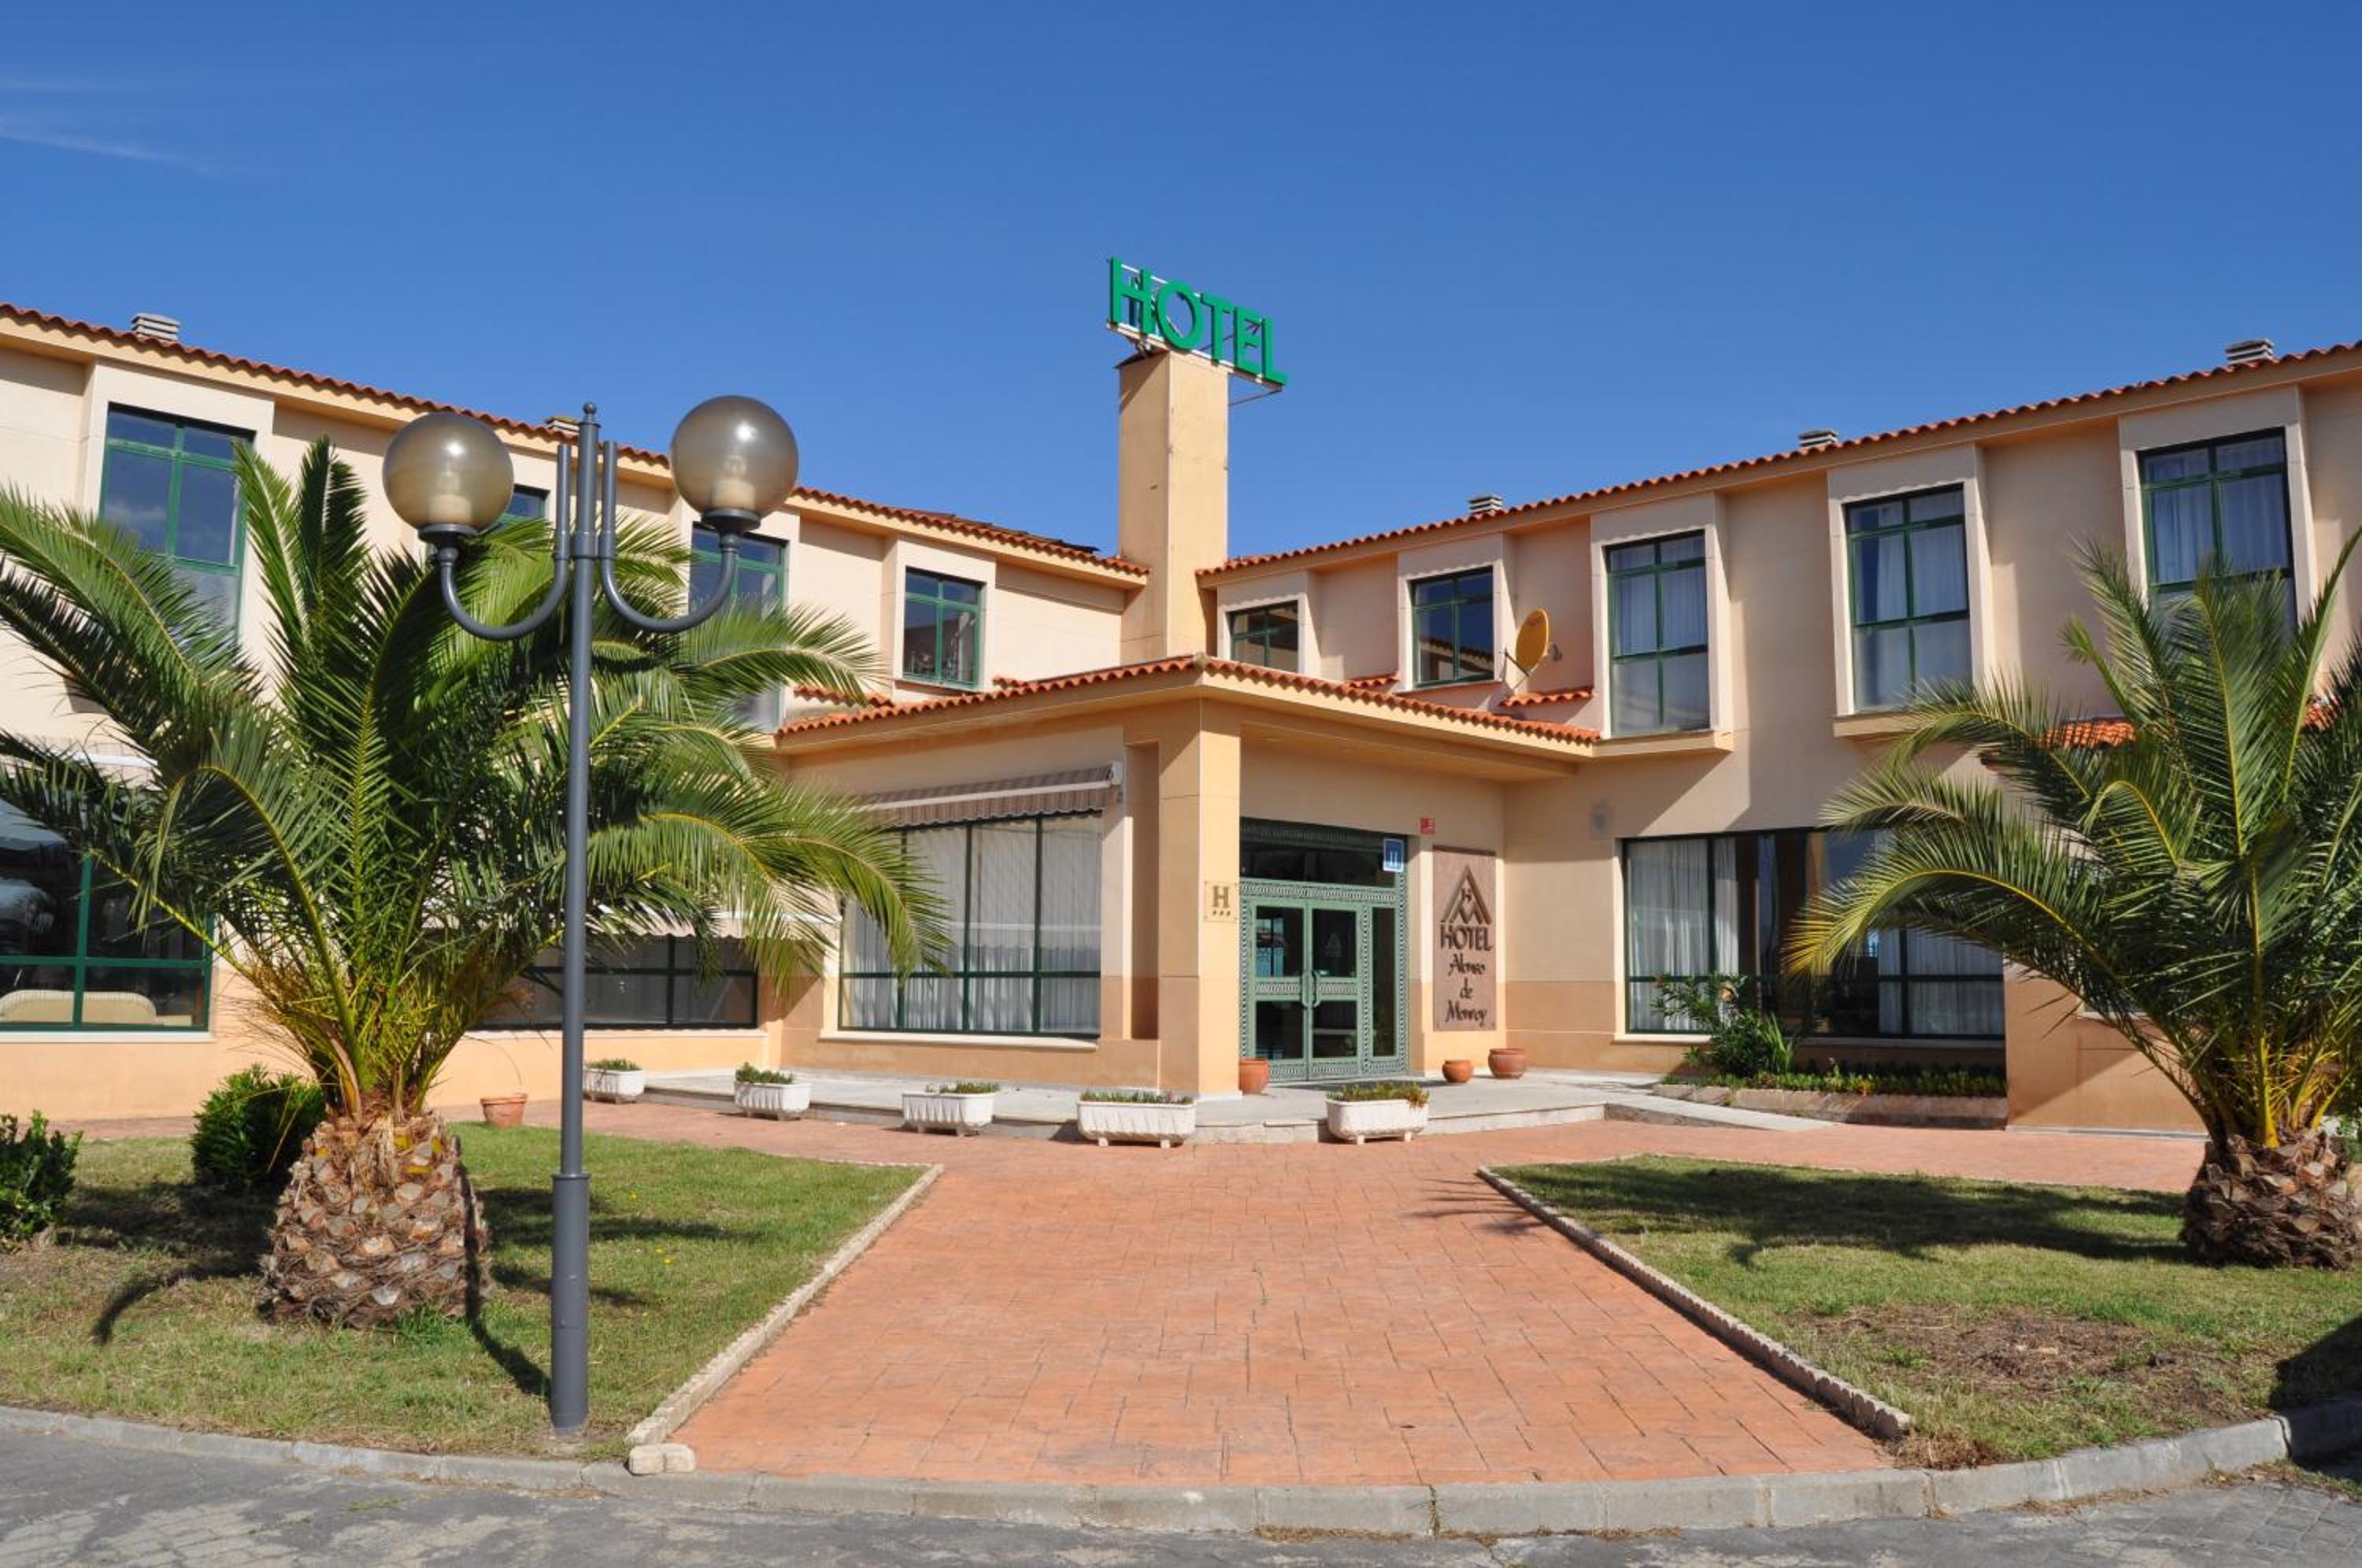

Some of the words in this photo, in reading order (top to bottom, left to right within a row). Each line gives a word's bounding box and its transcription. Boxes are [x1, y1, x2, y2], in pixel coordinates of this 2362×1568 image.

[1109, 257, 1287, 386] HOTEL
[1213, 886, 1229, 908] H
[1440, 924, 1493, 951] HOTEL
[1460, 977, 1473, 999] de
